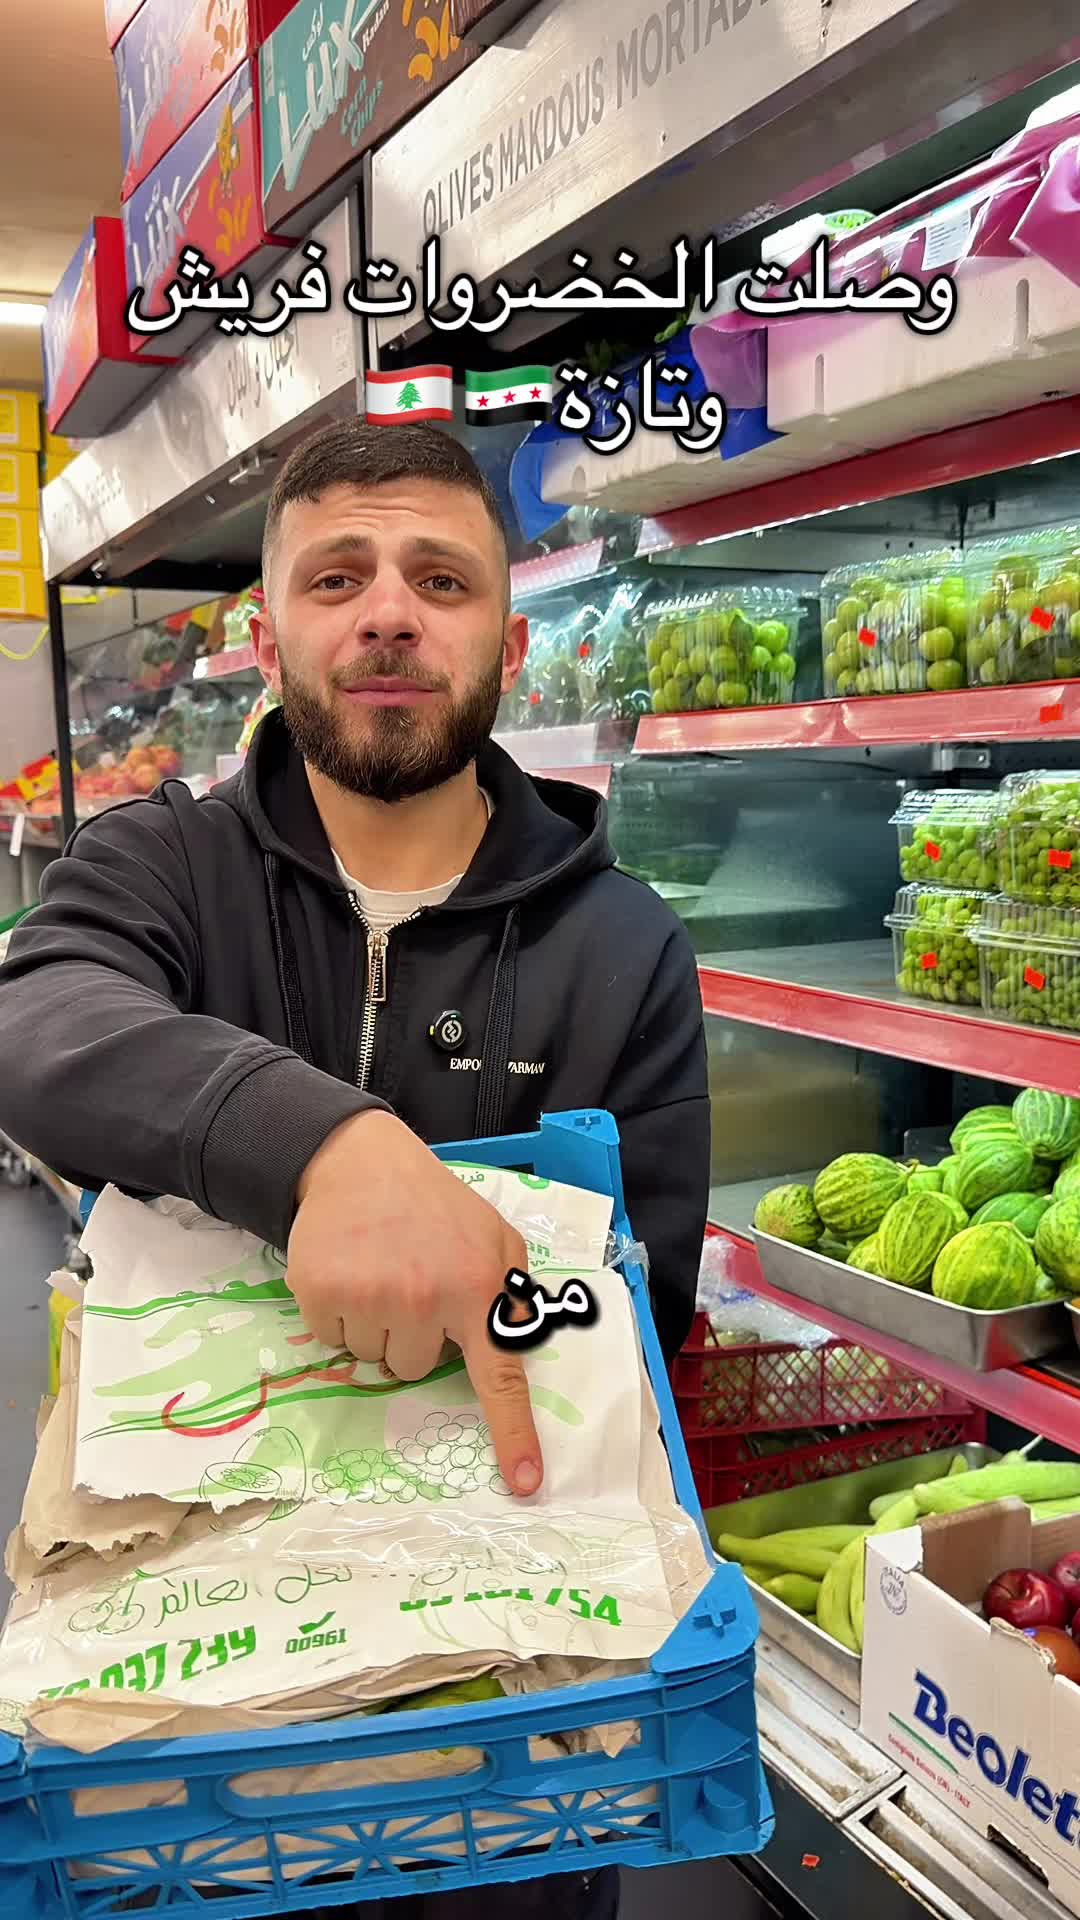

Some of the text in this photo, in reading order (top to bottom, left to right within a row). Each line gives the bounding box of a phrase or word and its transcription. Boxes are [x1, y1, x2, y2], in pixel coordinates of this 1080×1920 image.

[423, 143, 494, 237] OLIVES
[499, 56, 606, 192] MAKDOUS
[449, 1057, 482, 1072] EMPO
[284, 1627, 347, 1655] 00961
[913, 1667, 1080, 1842] Beolet
